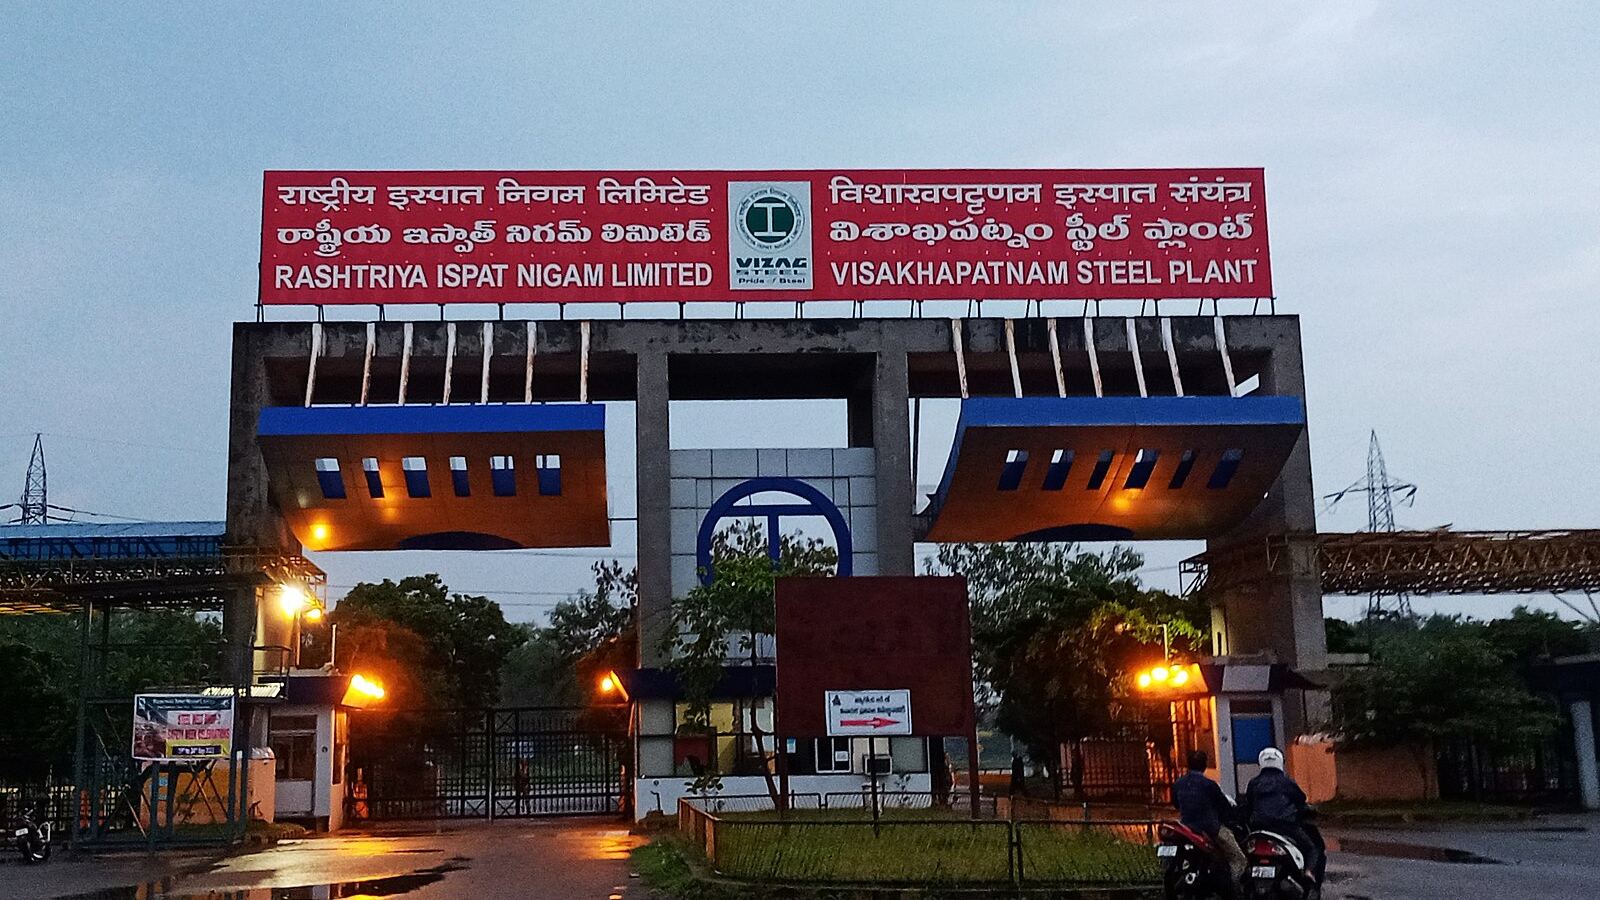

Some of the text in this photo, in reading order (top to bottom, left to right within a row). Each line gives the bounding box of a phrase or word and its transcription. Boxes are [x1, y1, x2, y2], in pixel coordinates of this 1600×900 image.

[277, 177, 377, 212] राष्ट्रीय
[386, 185, 485, 211] इस्पात
[495, 178, 586, 205] निगम
[596, 176, 711, 205] लिमिटेड
[1052, 183, 1158, 210] इस्पात
[1168, 176, 1252, 204] संयंत्र
[276, 218, 711, 257] రాష్ట్రీయ ఇస్పాత్ నిగమ్ లిమిటెడ్
[829, 212, 1255, 251] విశాఖపట్నం స్టీల్ ప్లాంట్
[275, 262, 713, 289] RASHTRIYA ISPAT NIGAM LIMITED
[736, 257, 807, 269] VIZAG
[830, 259, 1258, 286] VISAKHAPATNAM STEEL PLANT
